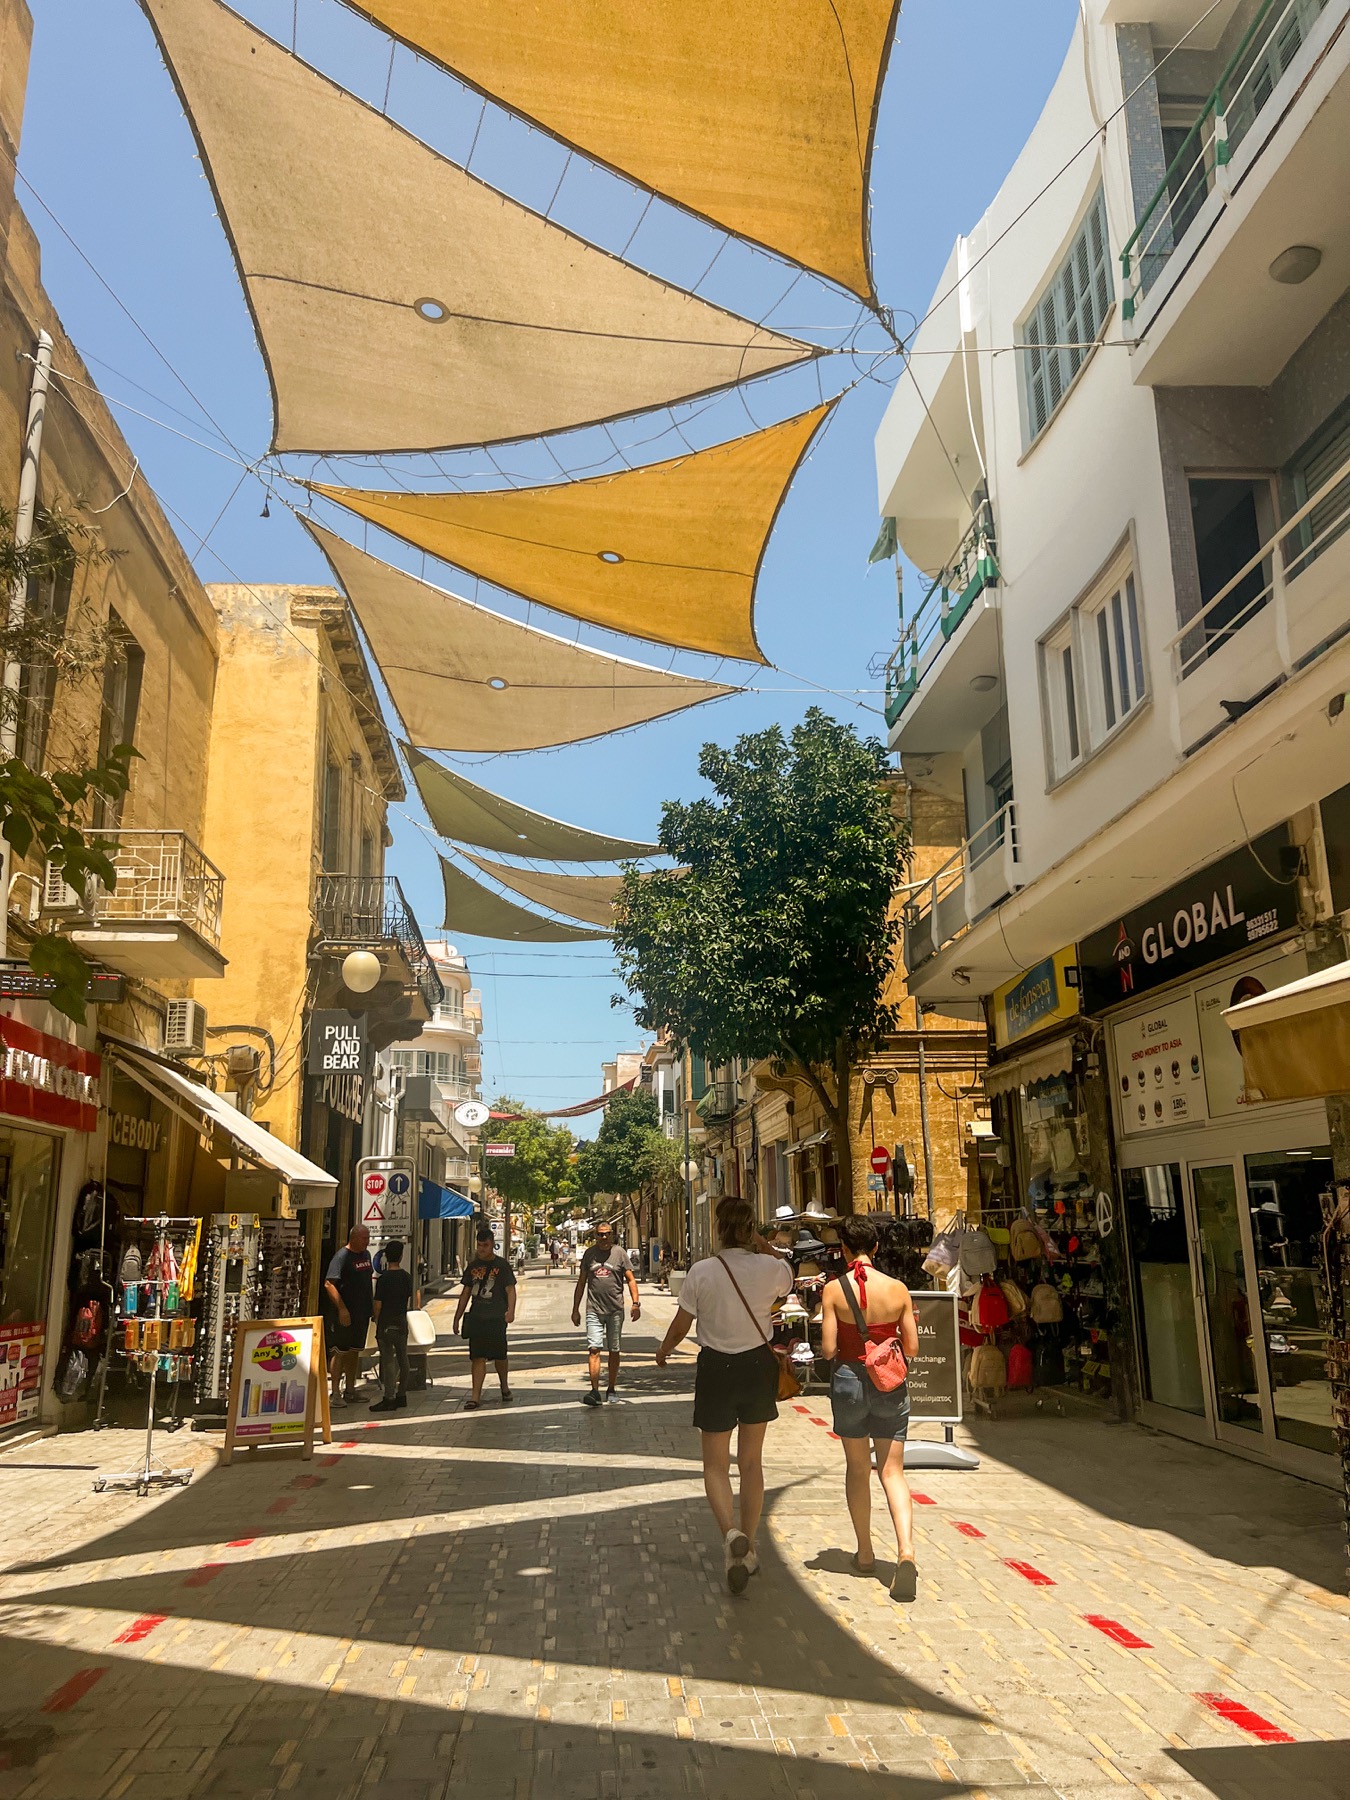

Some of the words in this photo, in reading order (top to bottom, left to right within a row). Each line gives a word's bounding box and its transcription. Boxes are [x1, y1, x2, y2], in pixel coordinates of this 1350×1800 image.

[1141, 884, 1245, 965] GLOBAL
[325, 1025, 360, 1040] PULL
[1147, 1019, 1168, 1032] GLOBAL
[331, 1040, 360, 1055] AND
[1131, 1050, 1144, 1061] SEND
[1145, 1045, 1161, 1057] MONEY
[1162, 1042, 1169, 1051] TO
[1170, 1038, 1182, 1049] ASIA
[323, 1055, 360, 1069] BEAR
[230, 1214, 238, 1226] 8
[254, 1351, 270, 1359] Any
[271, 1344, 284, 1360] 3
[913, 1355, 947, 1364] exchange
[912, 1394, 952, 1403] νομίσματος
